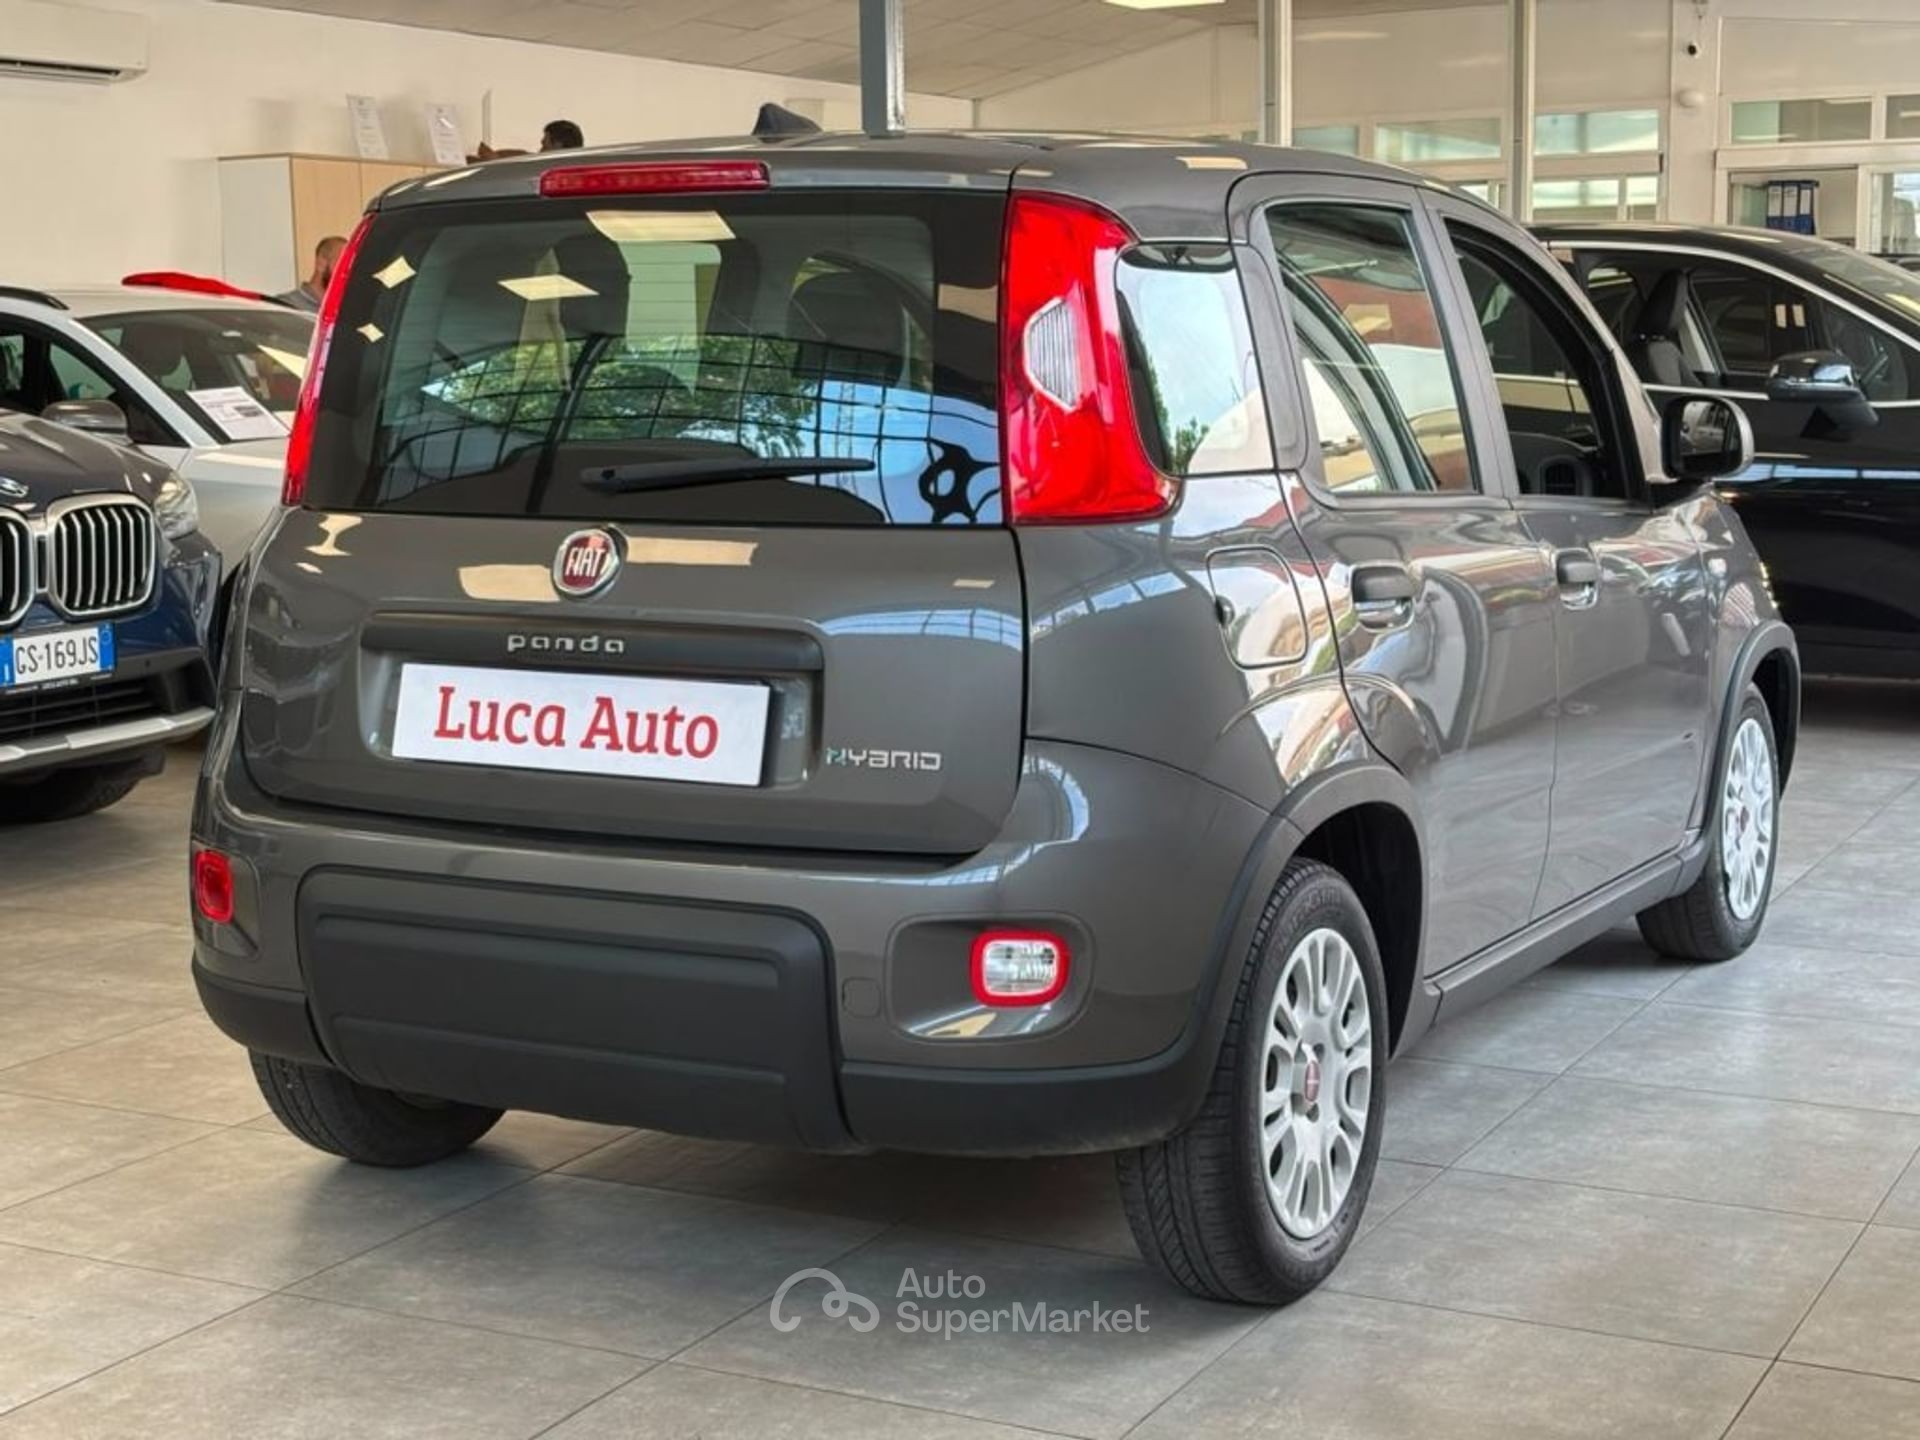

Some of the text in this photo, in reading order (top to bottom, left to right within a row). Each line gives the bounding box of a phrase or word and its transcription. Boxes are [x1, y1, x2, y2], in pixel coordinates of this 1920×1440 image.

[564, 547, 606, 577] FIAT
[507, 634, 624, 653] panda
[434, 686, 719, 759] Luca Auto
[826, 747, 941, 771] HYBRID
